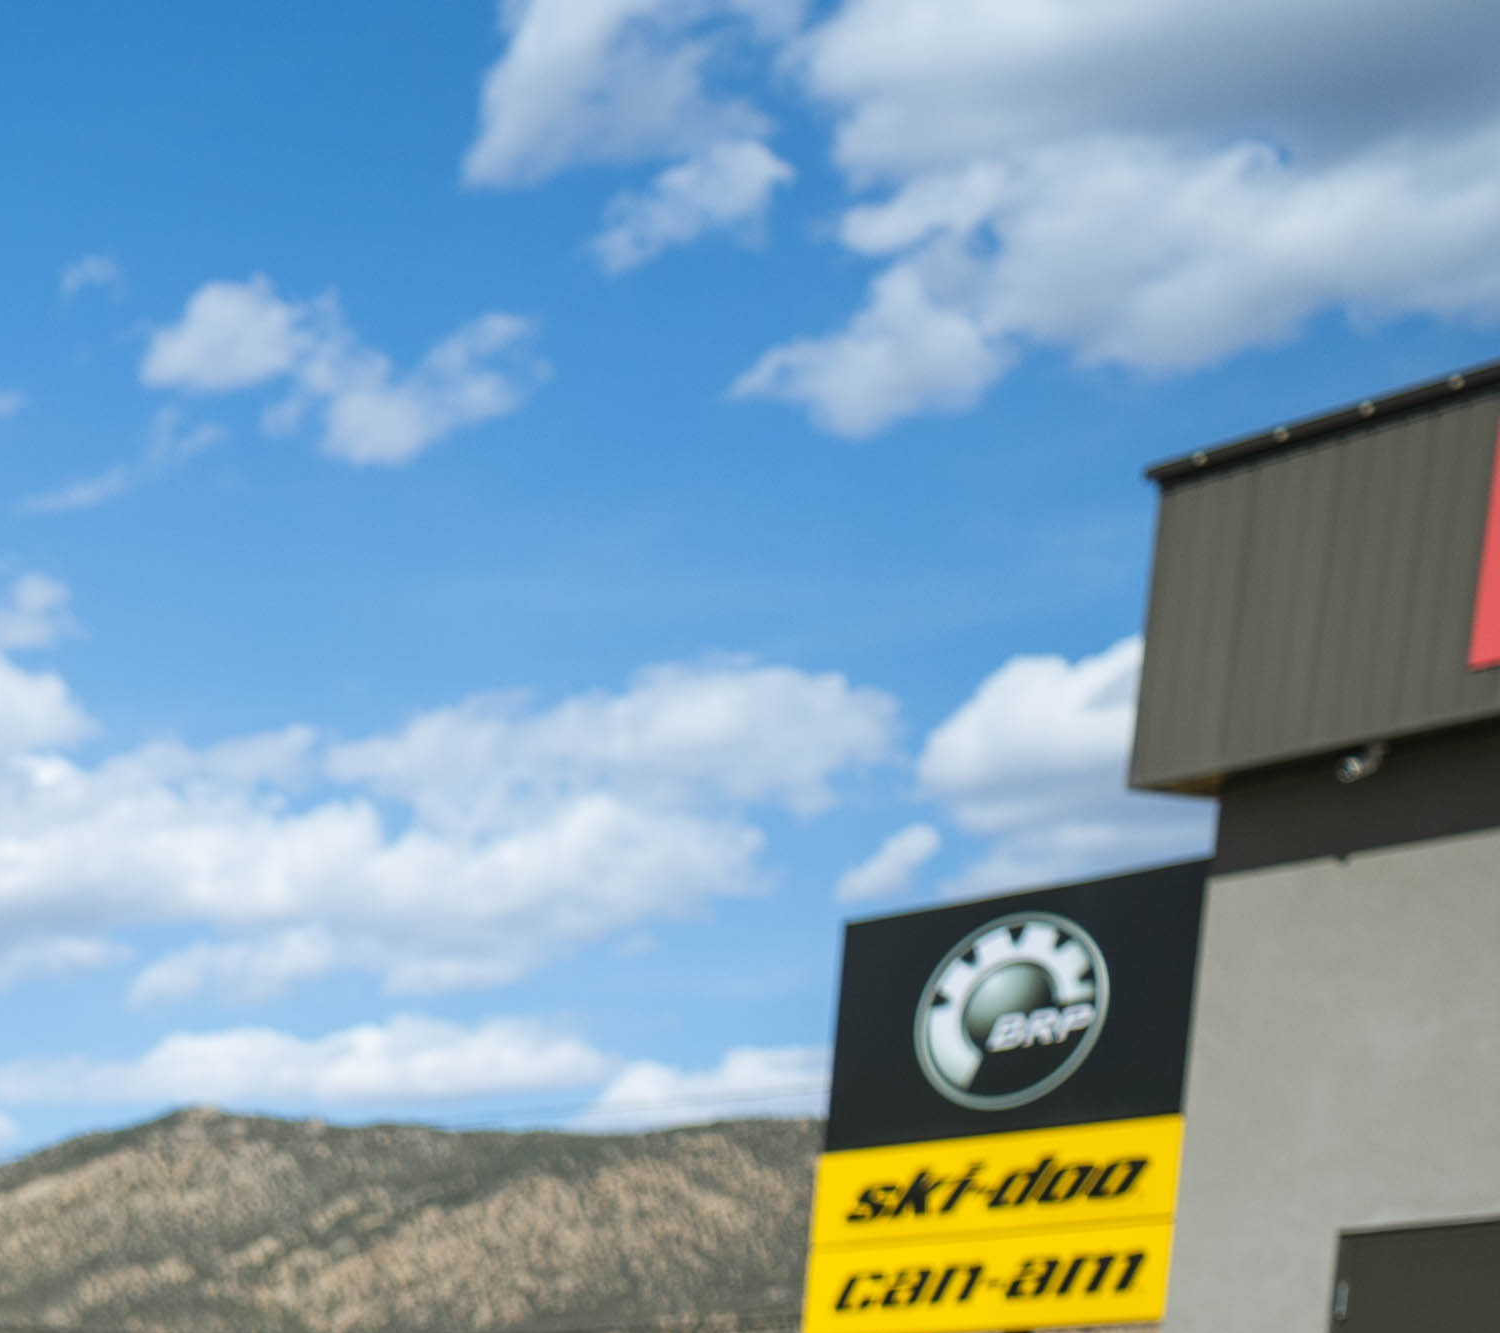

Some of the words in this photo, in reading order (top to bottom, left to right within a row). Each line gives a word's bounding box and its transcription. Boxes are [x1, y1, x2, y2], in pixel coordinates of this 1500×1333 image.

[986, 1003, 1097, 1053] BRP
[846, 1153, 1150, 1224] ski-doo
[835, 1250, 1148, 1314] can-am
